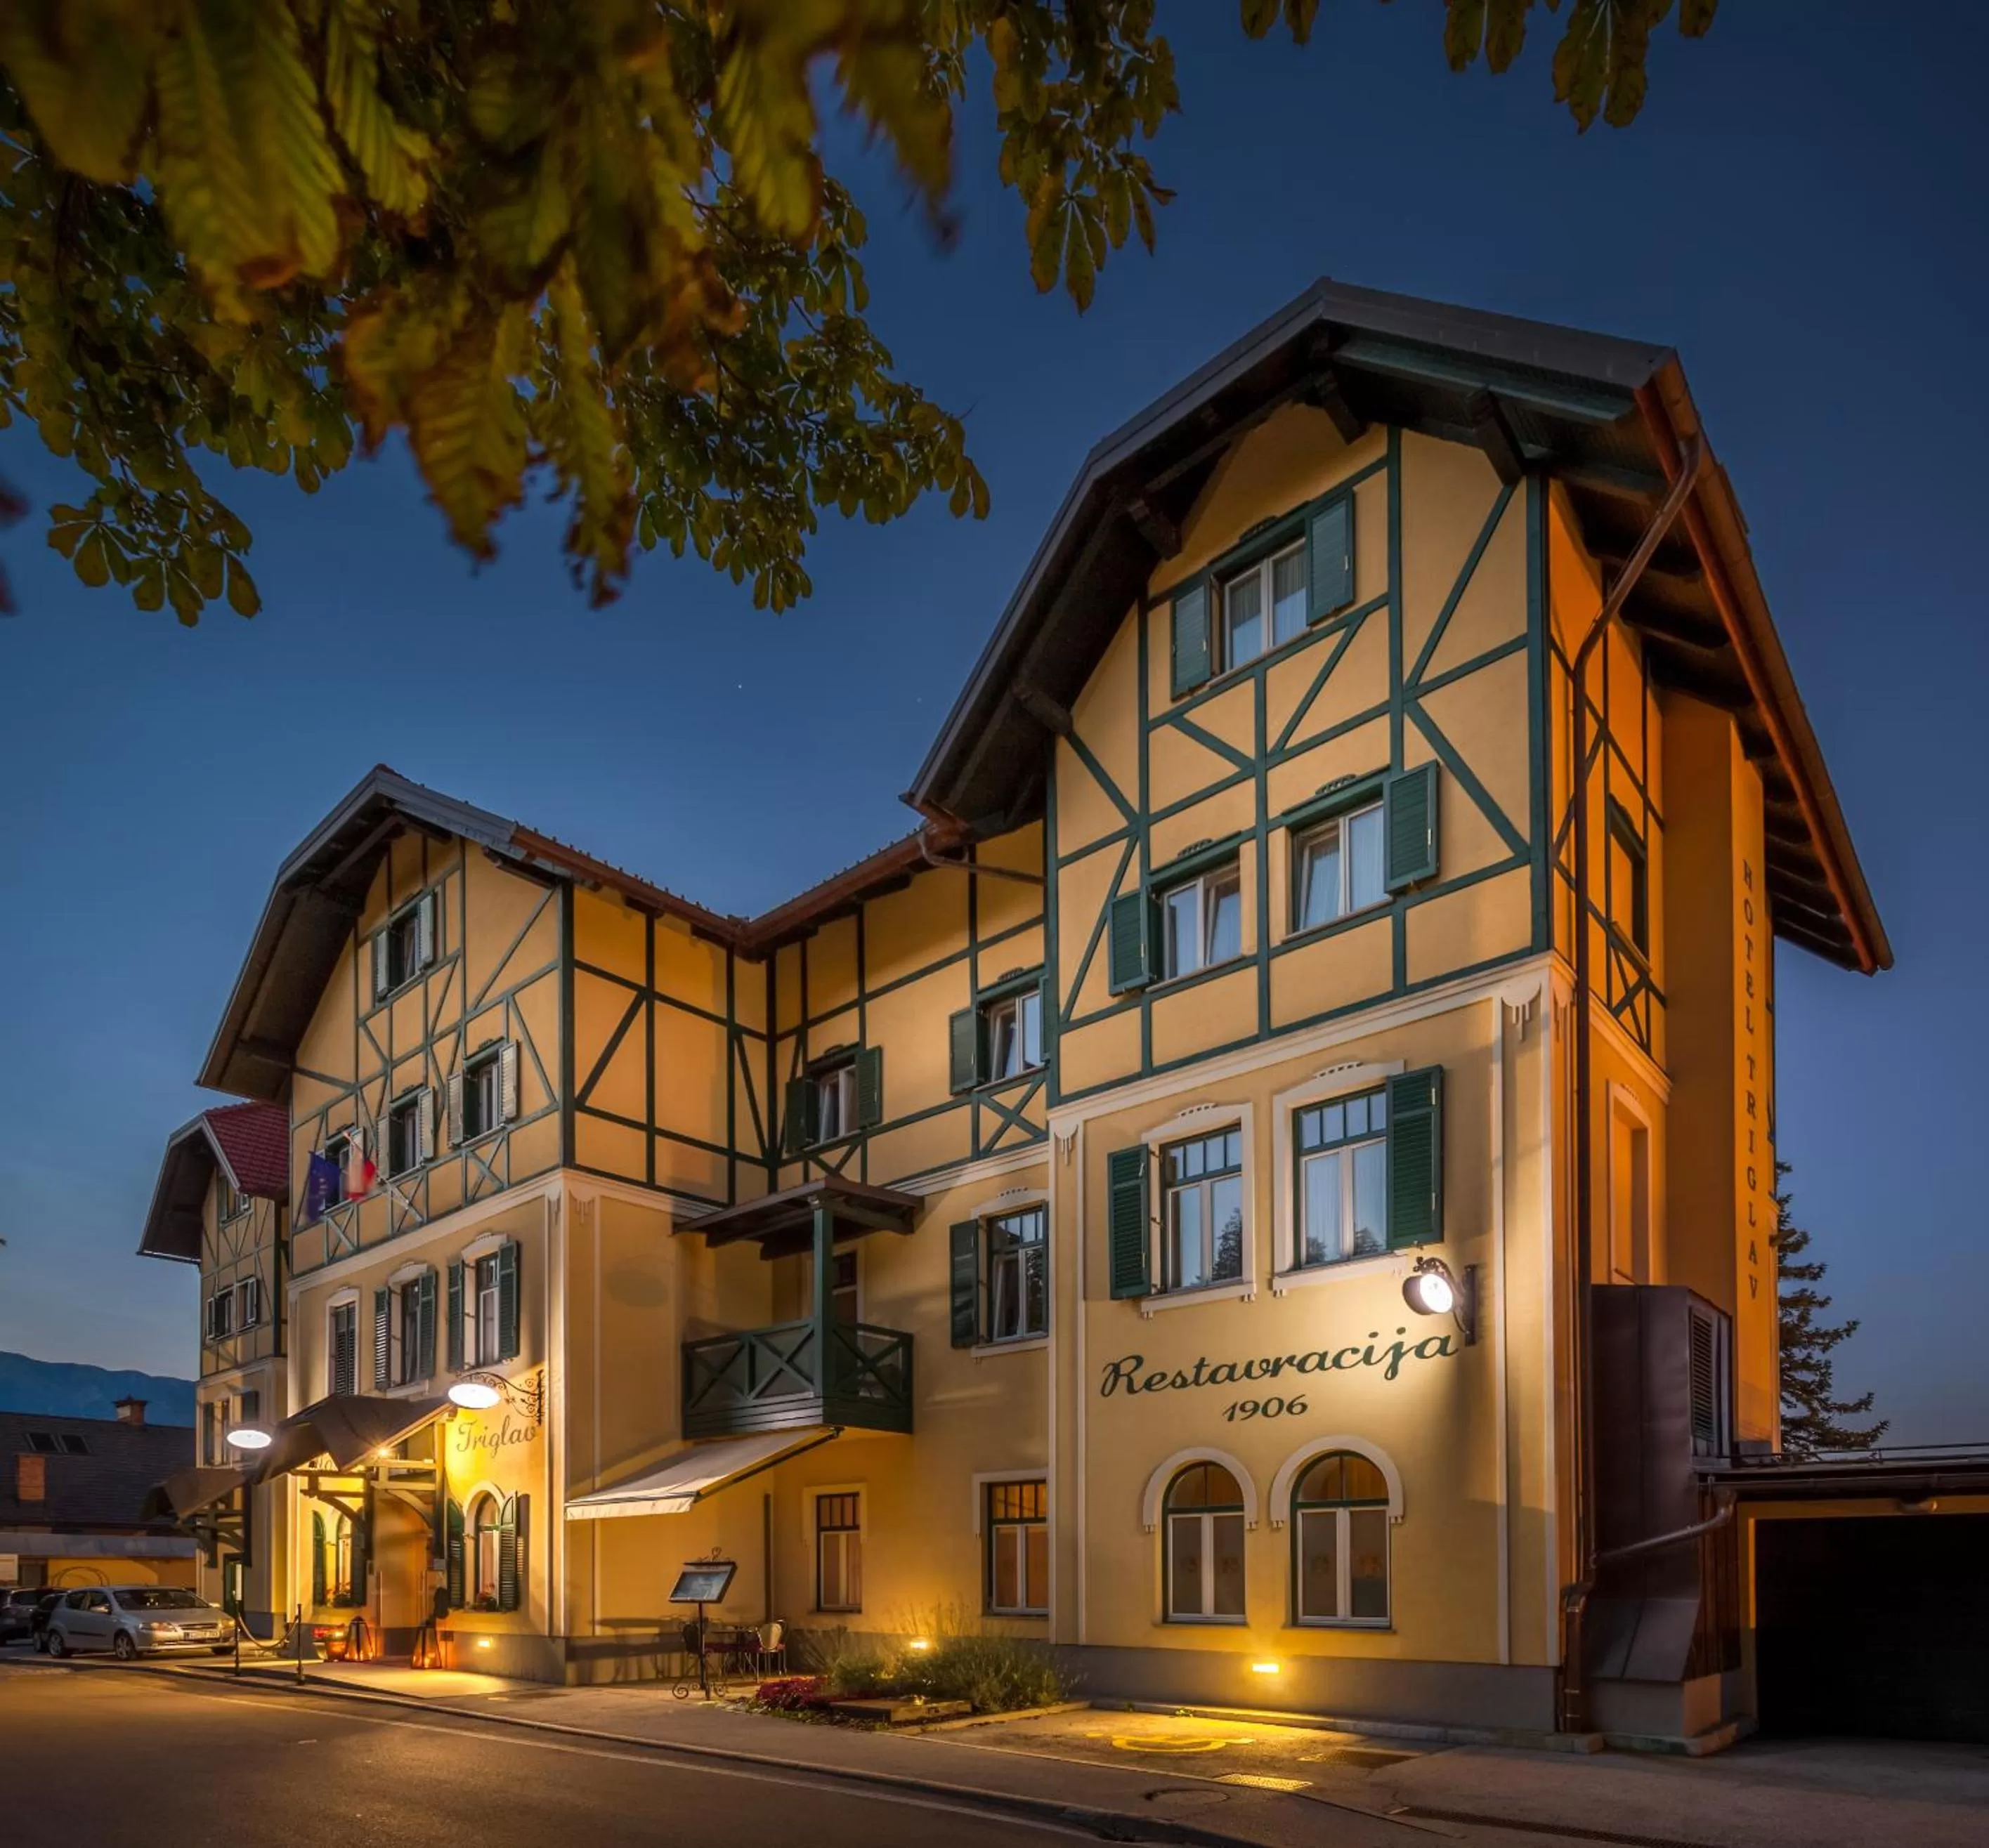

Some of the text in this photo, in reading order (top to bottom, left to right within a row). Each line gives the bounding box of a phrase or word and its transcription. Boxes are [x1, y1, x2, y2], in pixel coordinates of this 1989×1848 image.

[1742, 859, 1759, 1300] HOTEL TRIGLAV
[1100, 1327, 1459, 1398] Restavracija
[457, 1415, 536, 1458] Triglav
[1222, 1394, 1308, 1422] 1906
